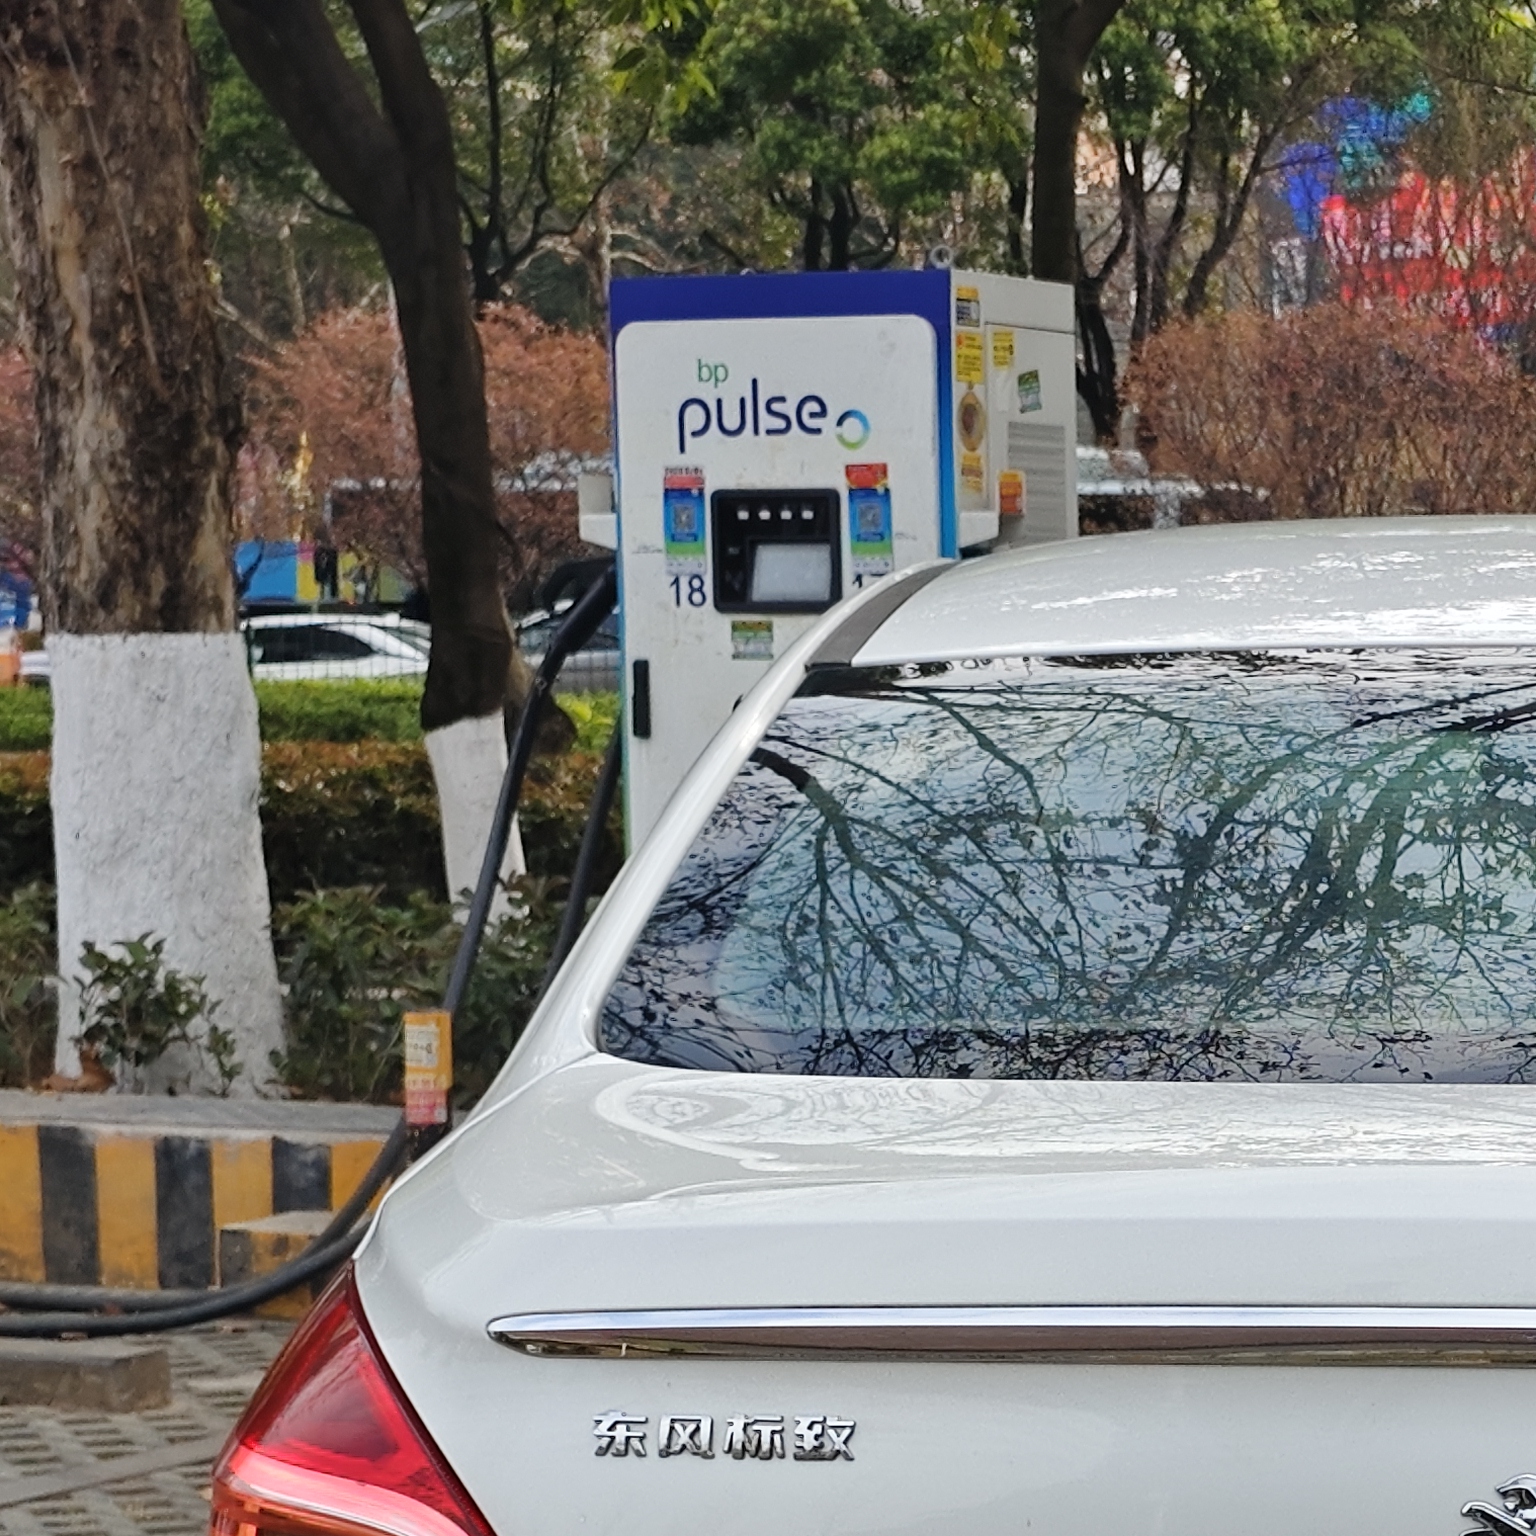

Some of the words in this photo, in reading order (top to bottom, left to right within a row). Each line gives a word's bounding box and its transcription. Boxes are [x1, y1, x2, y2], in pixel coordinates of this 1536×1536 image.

[697, 359, 729, 388] bp
[678, 377, 828, 454] pulse
[669, 573, 707, 608] 18
[592, 1409, 856, 1461] 东风标致
